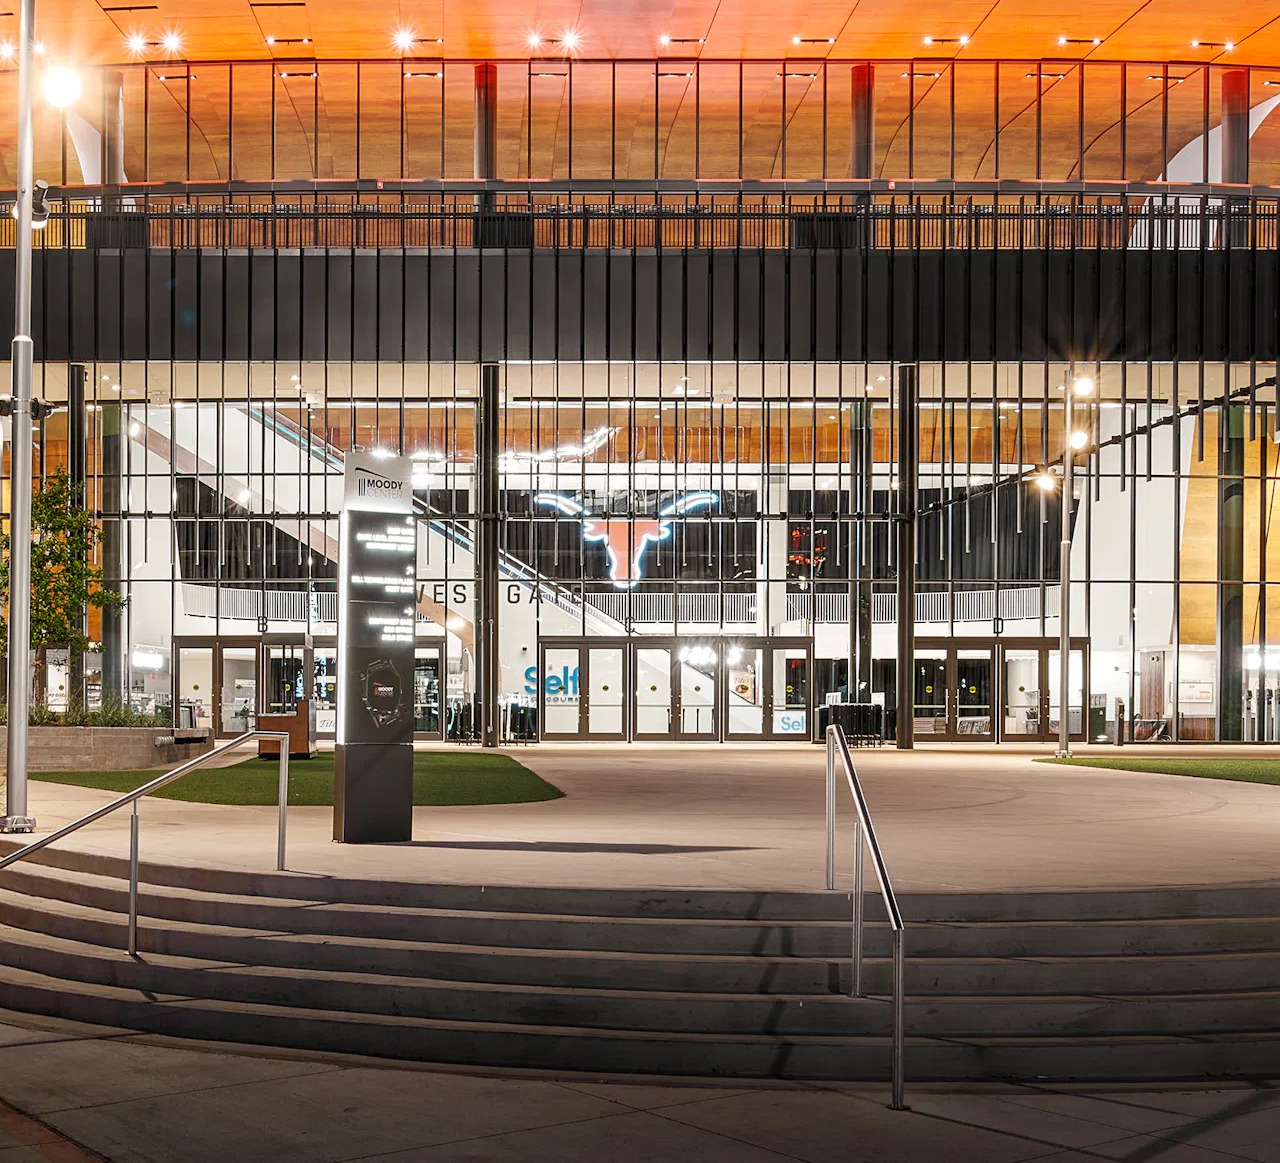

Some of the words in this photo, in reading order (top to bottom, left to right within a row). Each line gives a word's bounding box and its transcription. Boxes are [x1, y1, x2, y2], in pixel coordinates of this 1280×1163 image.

[367, 479, 403, 490] MOODY
[366, 488, 403, 500] CENTER
[257, 616, 268, 633] B
[993, 617, 1004, 634] D
[781, 715, 804, 731] Sel
